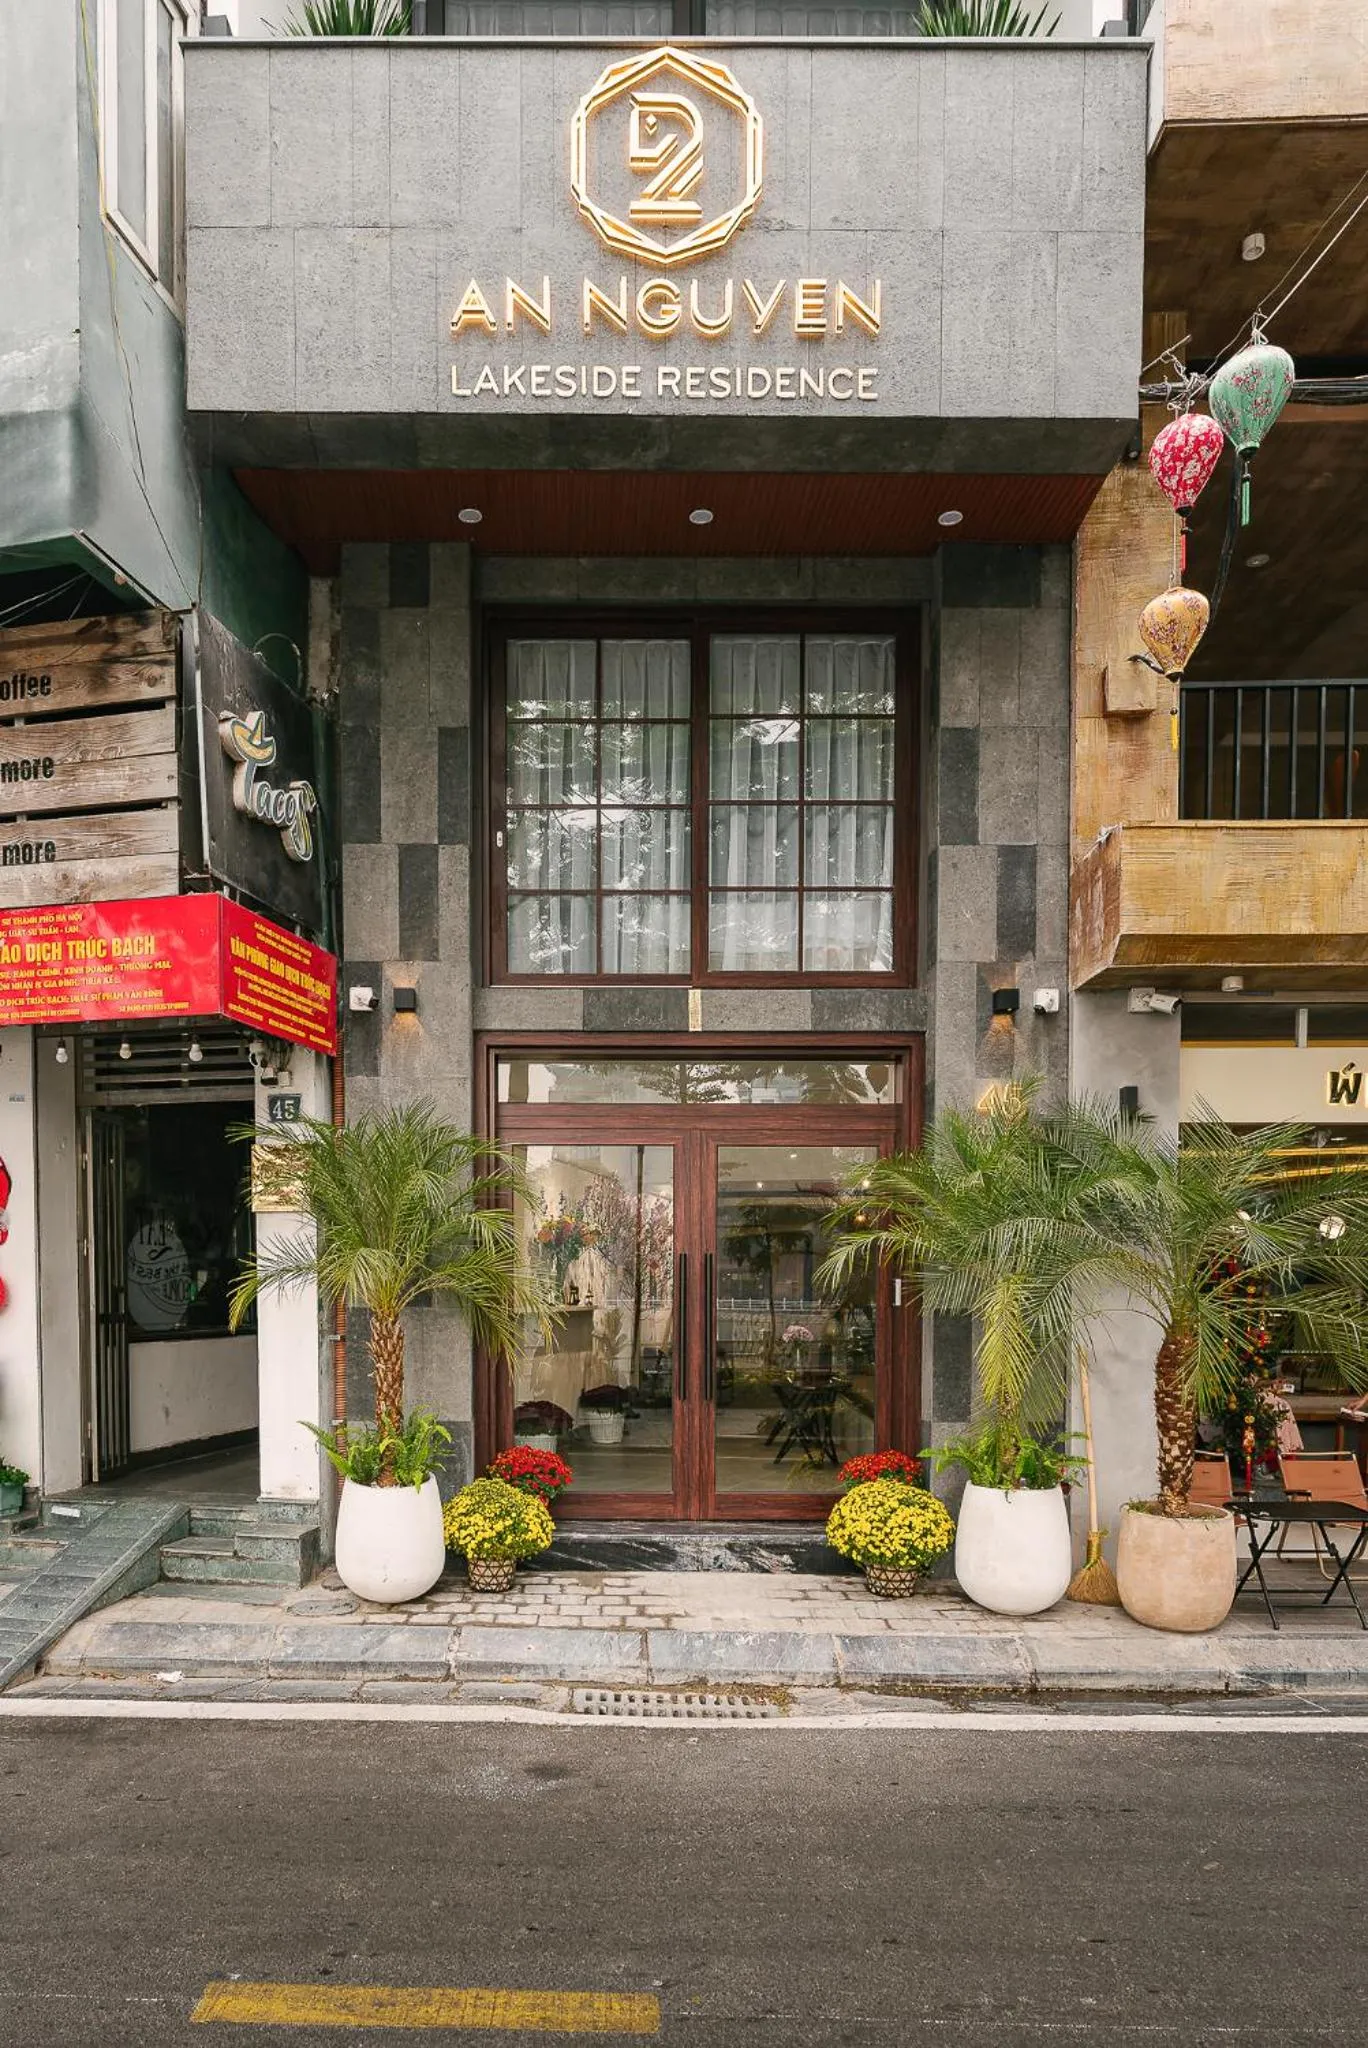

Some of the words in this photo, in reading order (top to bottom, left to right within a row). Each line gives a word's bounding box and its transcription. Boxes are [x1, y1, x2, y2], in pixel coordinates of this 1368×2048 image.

[450, 275, 551, 332] AN
[582, 276, 881, 335] NGUYEN
[450, 364, 642, 398] LAKESIDE
[656, 365, 880, 401] RESIDENCE
[0, 757, 54, 783] more
[2, 840, 57, 866] more
[25, 941, 63, 967] DỊCH
[66, 934, 108, 961] TRÚC
[111, 935, 155, 961] BẠCH
[1327, 1061, 1368, 1106] Ẃ
[272, 1099, 295, 1120] 45
